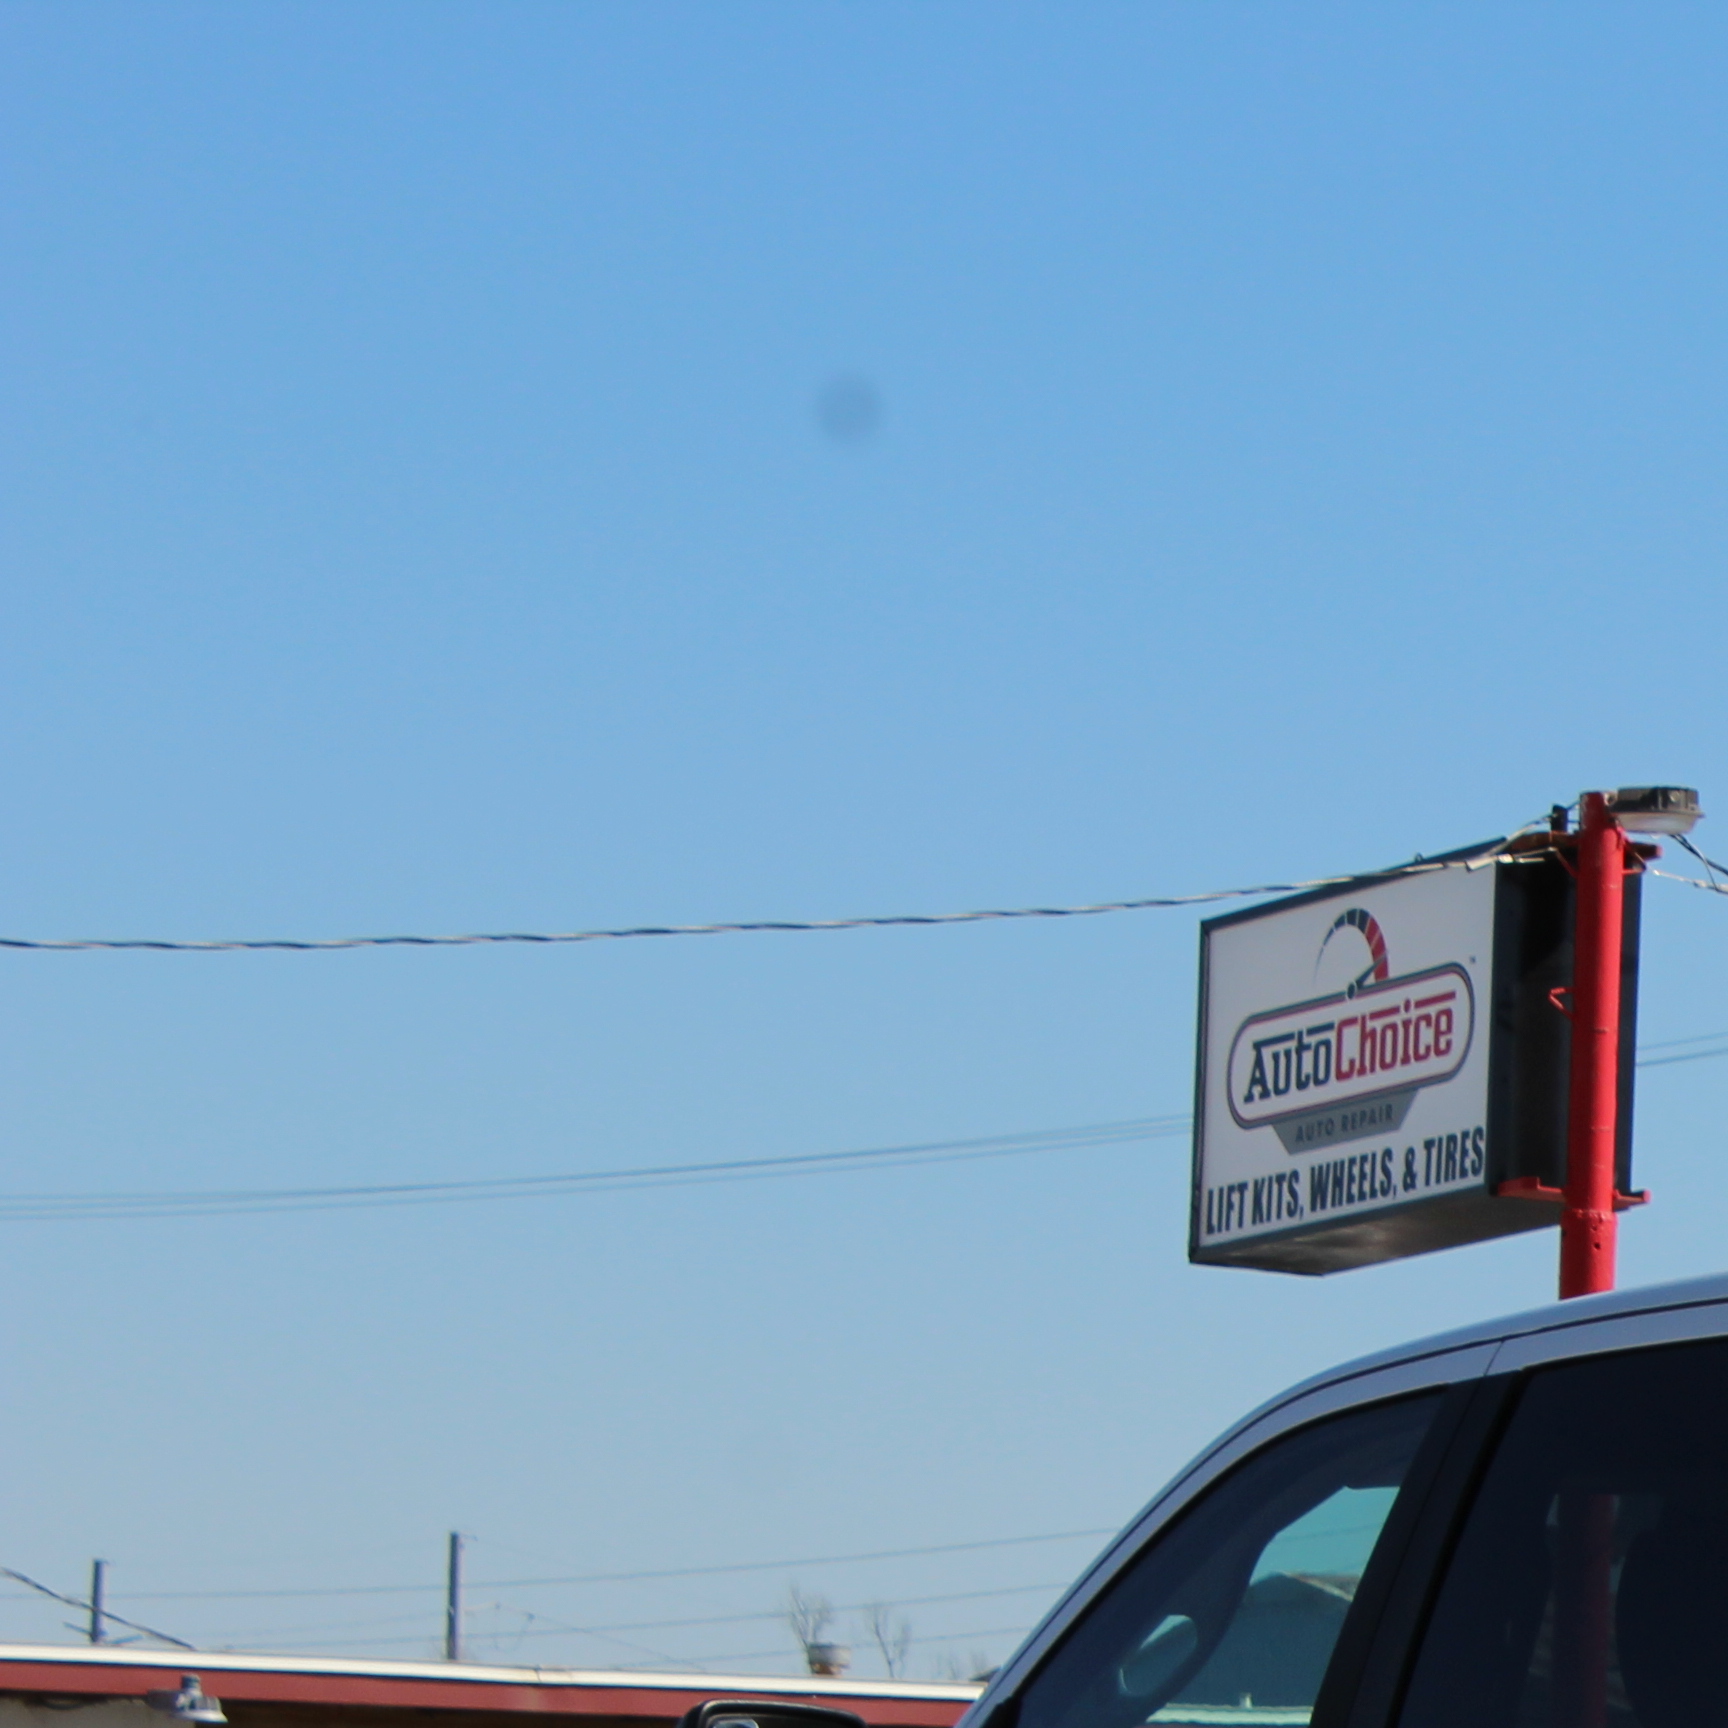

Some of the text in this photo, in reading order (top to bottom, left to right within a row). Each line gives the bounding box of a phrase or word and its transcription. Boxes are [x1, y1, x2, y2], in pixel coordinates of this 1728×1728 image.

[1295, 1103, 1393, 1143] AUTO REPAIR
[1206, 1125, 1486, 1235] LIFT KITS, WHEELS, & TIRES
